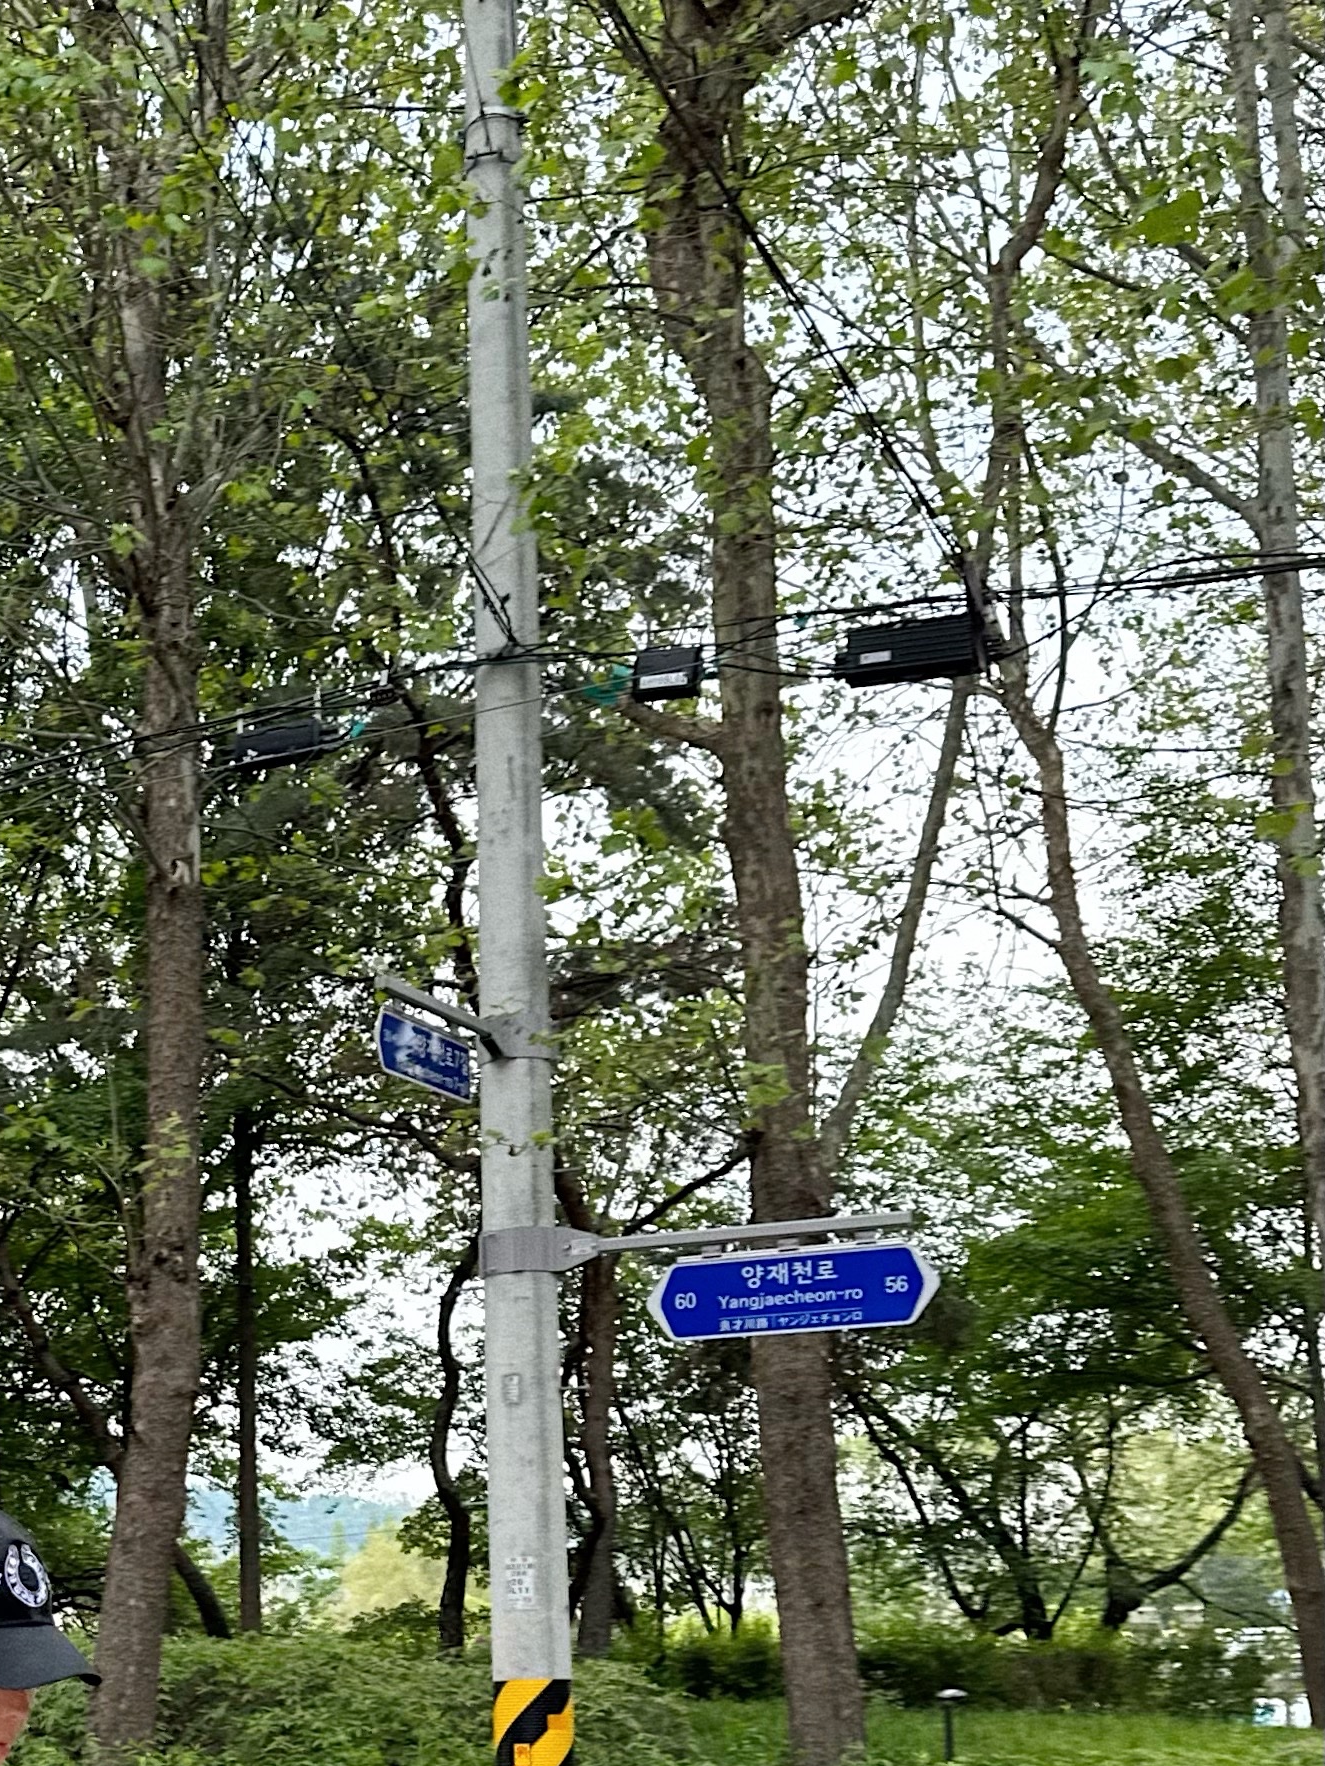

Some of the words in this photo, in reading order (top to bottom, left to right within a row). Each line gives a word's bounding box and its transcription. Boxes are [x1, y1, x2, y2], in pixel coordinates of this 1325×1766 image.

[740, 1259, 839, 1289] 양재천로
[884, 1275, 909, 1294] 56
[674, 1291, 697, 1310] 60
[717, 1287, 863, 1311] Yangjaecheon-ro
